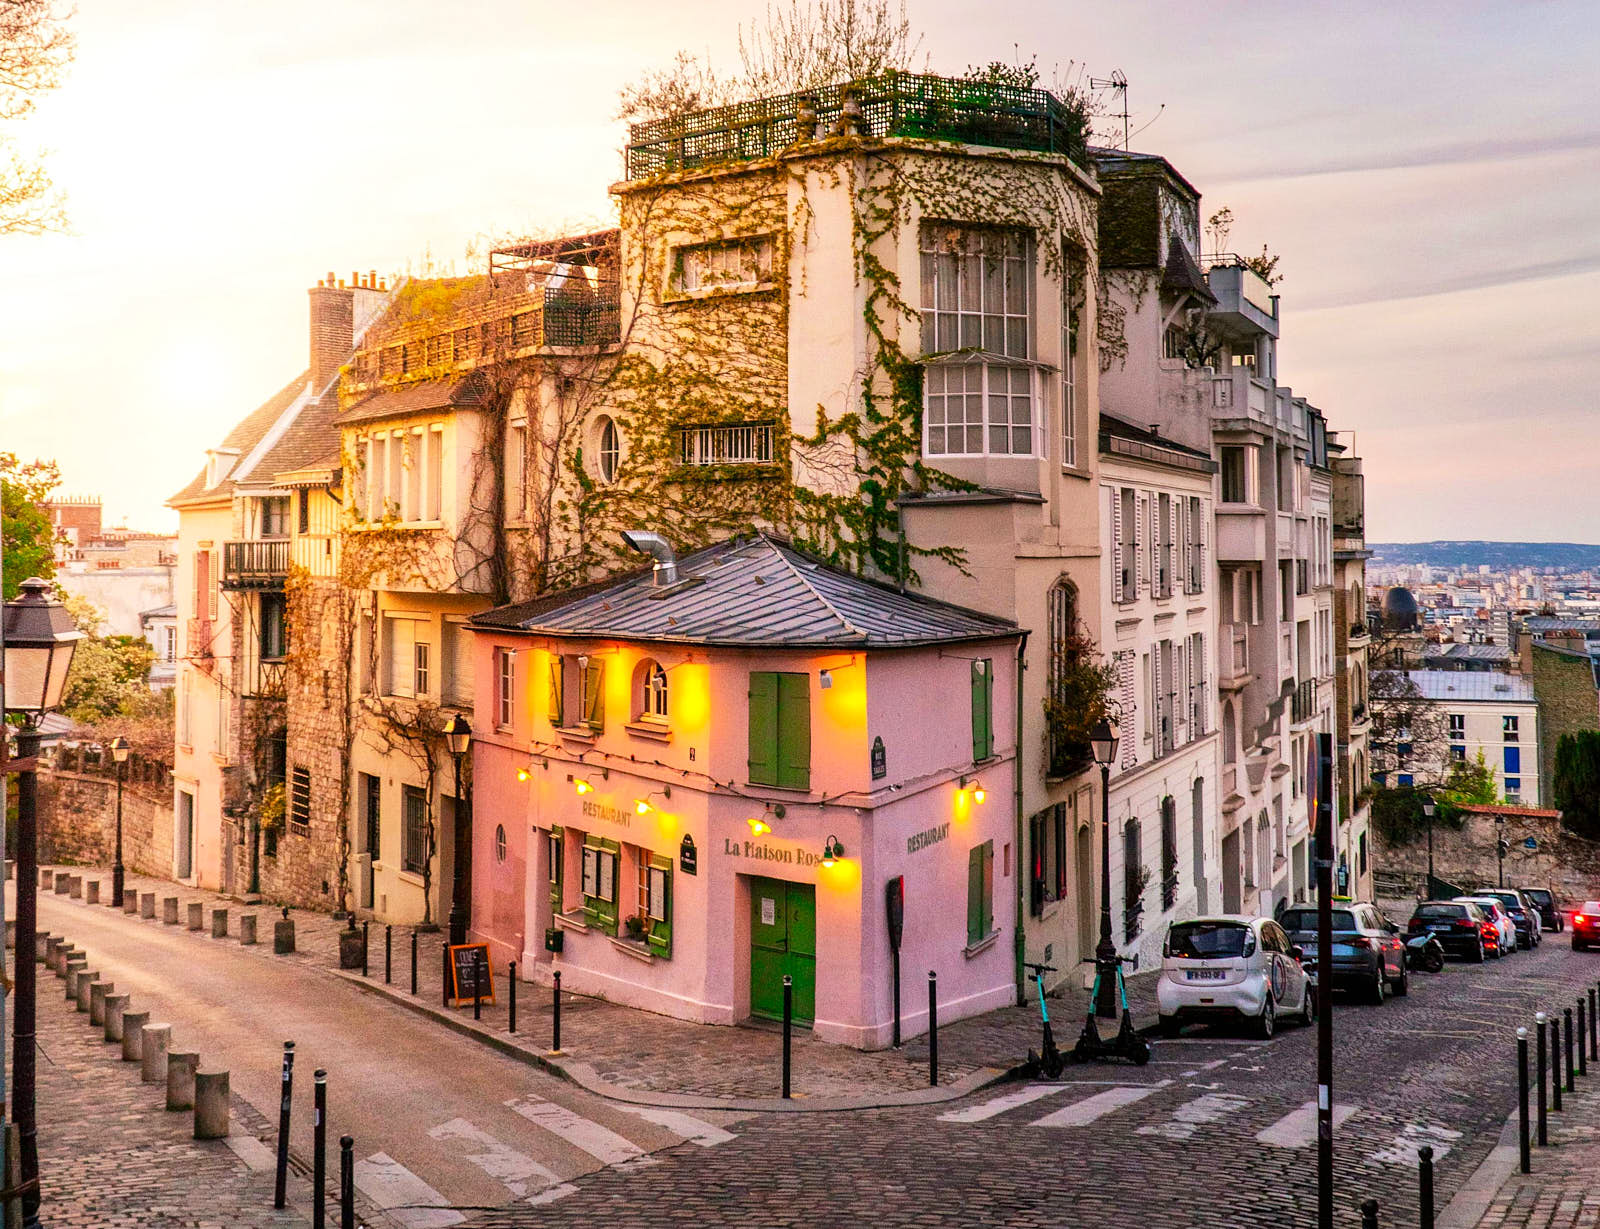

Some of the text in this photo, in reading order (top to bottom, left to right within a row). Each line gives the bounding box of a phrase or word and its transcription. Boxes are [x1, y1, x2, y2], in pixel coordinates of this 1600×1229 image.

[582, 801, 632, 828] RESTAURANT
[724, 838, 741, 856] La
[743, 841, 792, 864] Maison
[907, 822, 950, 855] RESTAURANT
